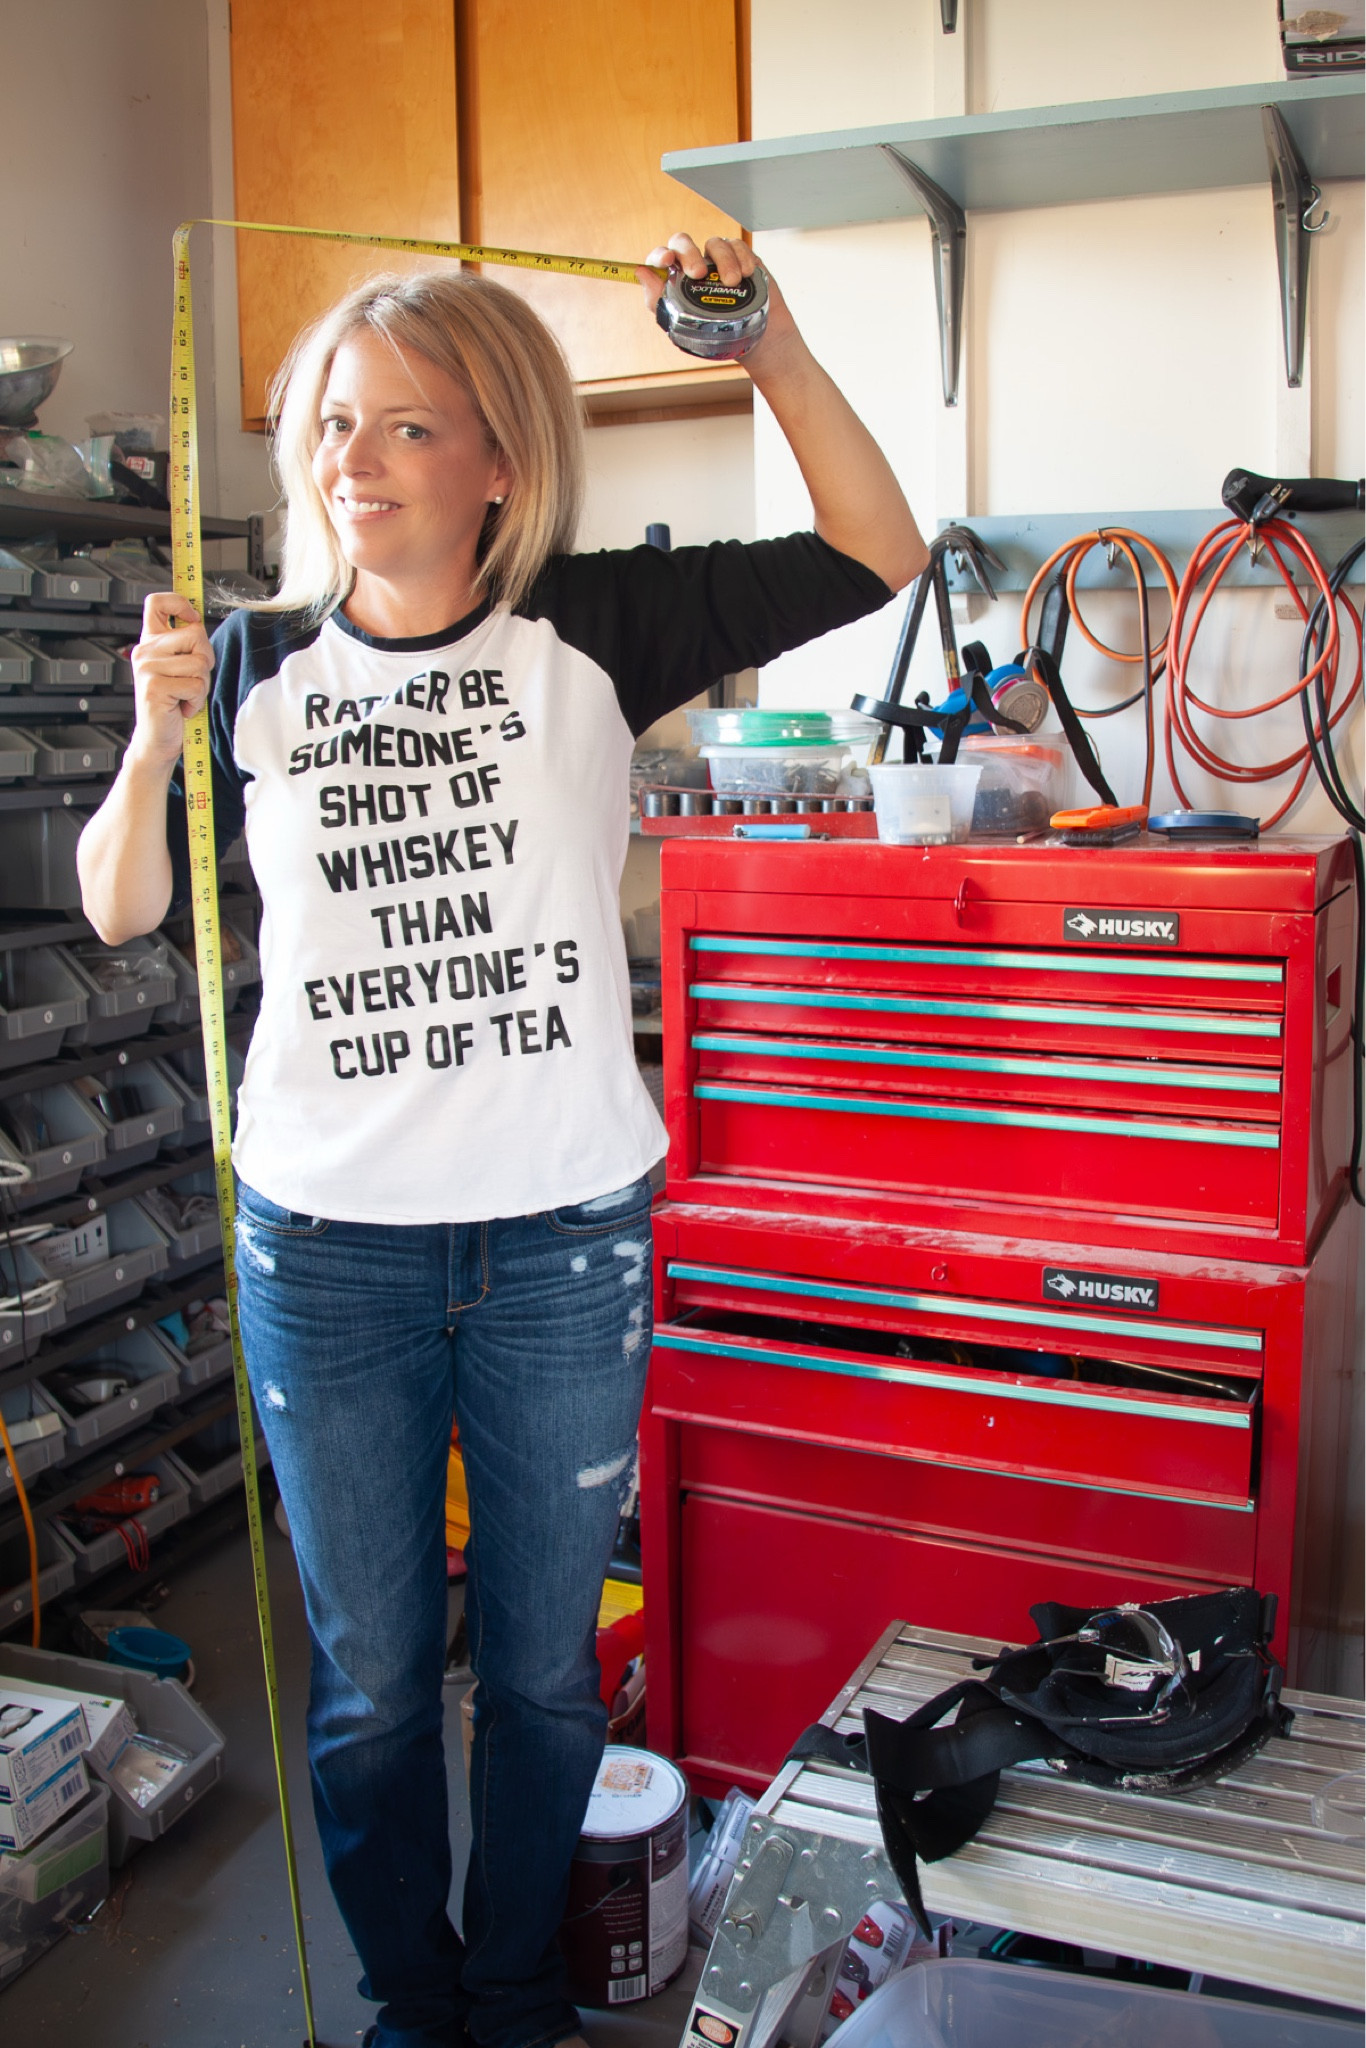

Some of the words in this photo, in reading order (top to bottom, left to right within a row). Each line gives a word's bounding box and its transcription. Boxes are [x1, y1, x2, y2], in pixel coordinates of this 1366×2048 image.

[1297, 51, 1365, 63] RID
[434, 243, 451, 251] 73
[467, 247, 484, 256] 74
[500, 252, 518, 260] 75
[534, 256, 552, 265] 76
[568, 260, 585, 269] 77
[601, 265, 619, 274] 78
[179, 329, 187, 346] 62
[180, 366, 188, 380] 61
[181, 397, 189, 414] 60
[182, 431, 190, 448] 59
[183, 464, 191, 481] 58
[184, 498, 192, 515] 57
[186, 531, 193, 548] 56
[187, 564, 195, 581] 55
[459, 669, 510, 710] BE
[194, 728, 202, 745] 50
[288, 710, 527, 776] SOMEONE'S
[196, 760, 204, 776] 49
[319, 783, 432, 828] SHOT
[448, 763, 501, 809] OF
[199, 825, 207, 840] 47
[201, 856, 209, 872] 46
[316, 819, 519, 893] WHISKEY
[203, 887, 210, 903] 45
[205, 919, 212, 934] 44
[370, 891, 493, 949] THAN
[1098, 918, 1174, 938] HUSKY
[206, 949, 214, 964] 43
[208, 980, 215, 995] 42
[304, 939, 580, 1021] EVERYONE'S
[329, 1030, 411, 1080] CUP
[425, 1022, 474, 1070] OF
[489, 1005, 572, 1057] TEA
[220, 1158, 227, 1174] 36
[222, 1188, 229, 1203] 35
[1079, 1280, 1155, 1304] HUSKY
